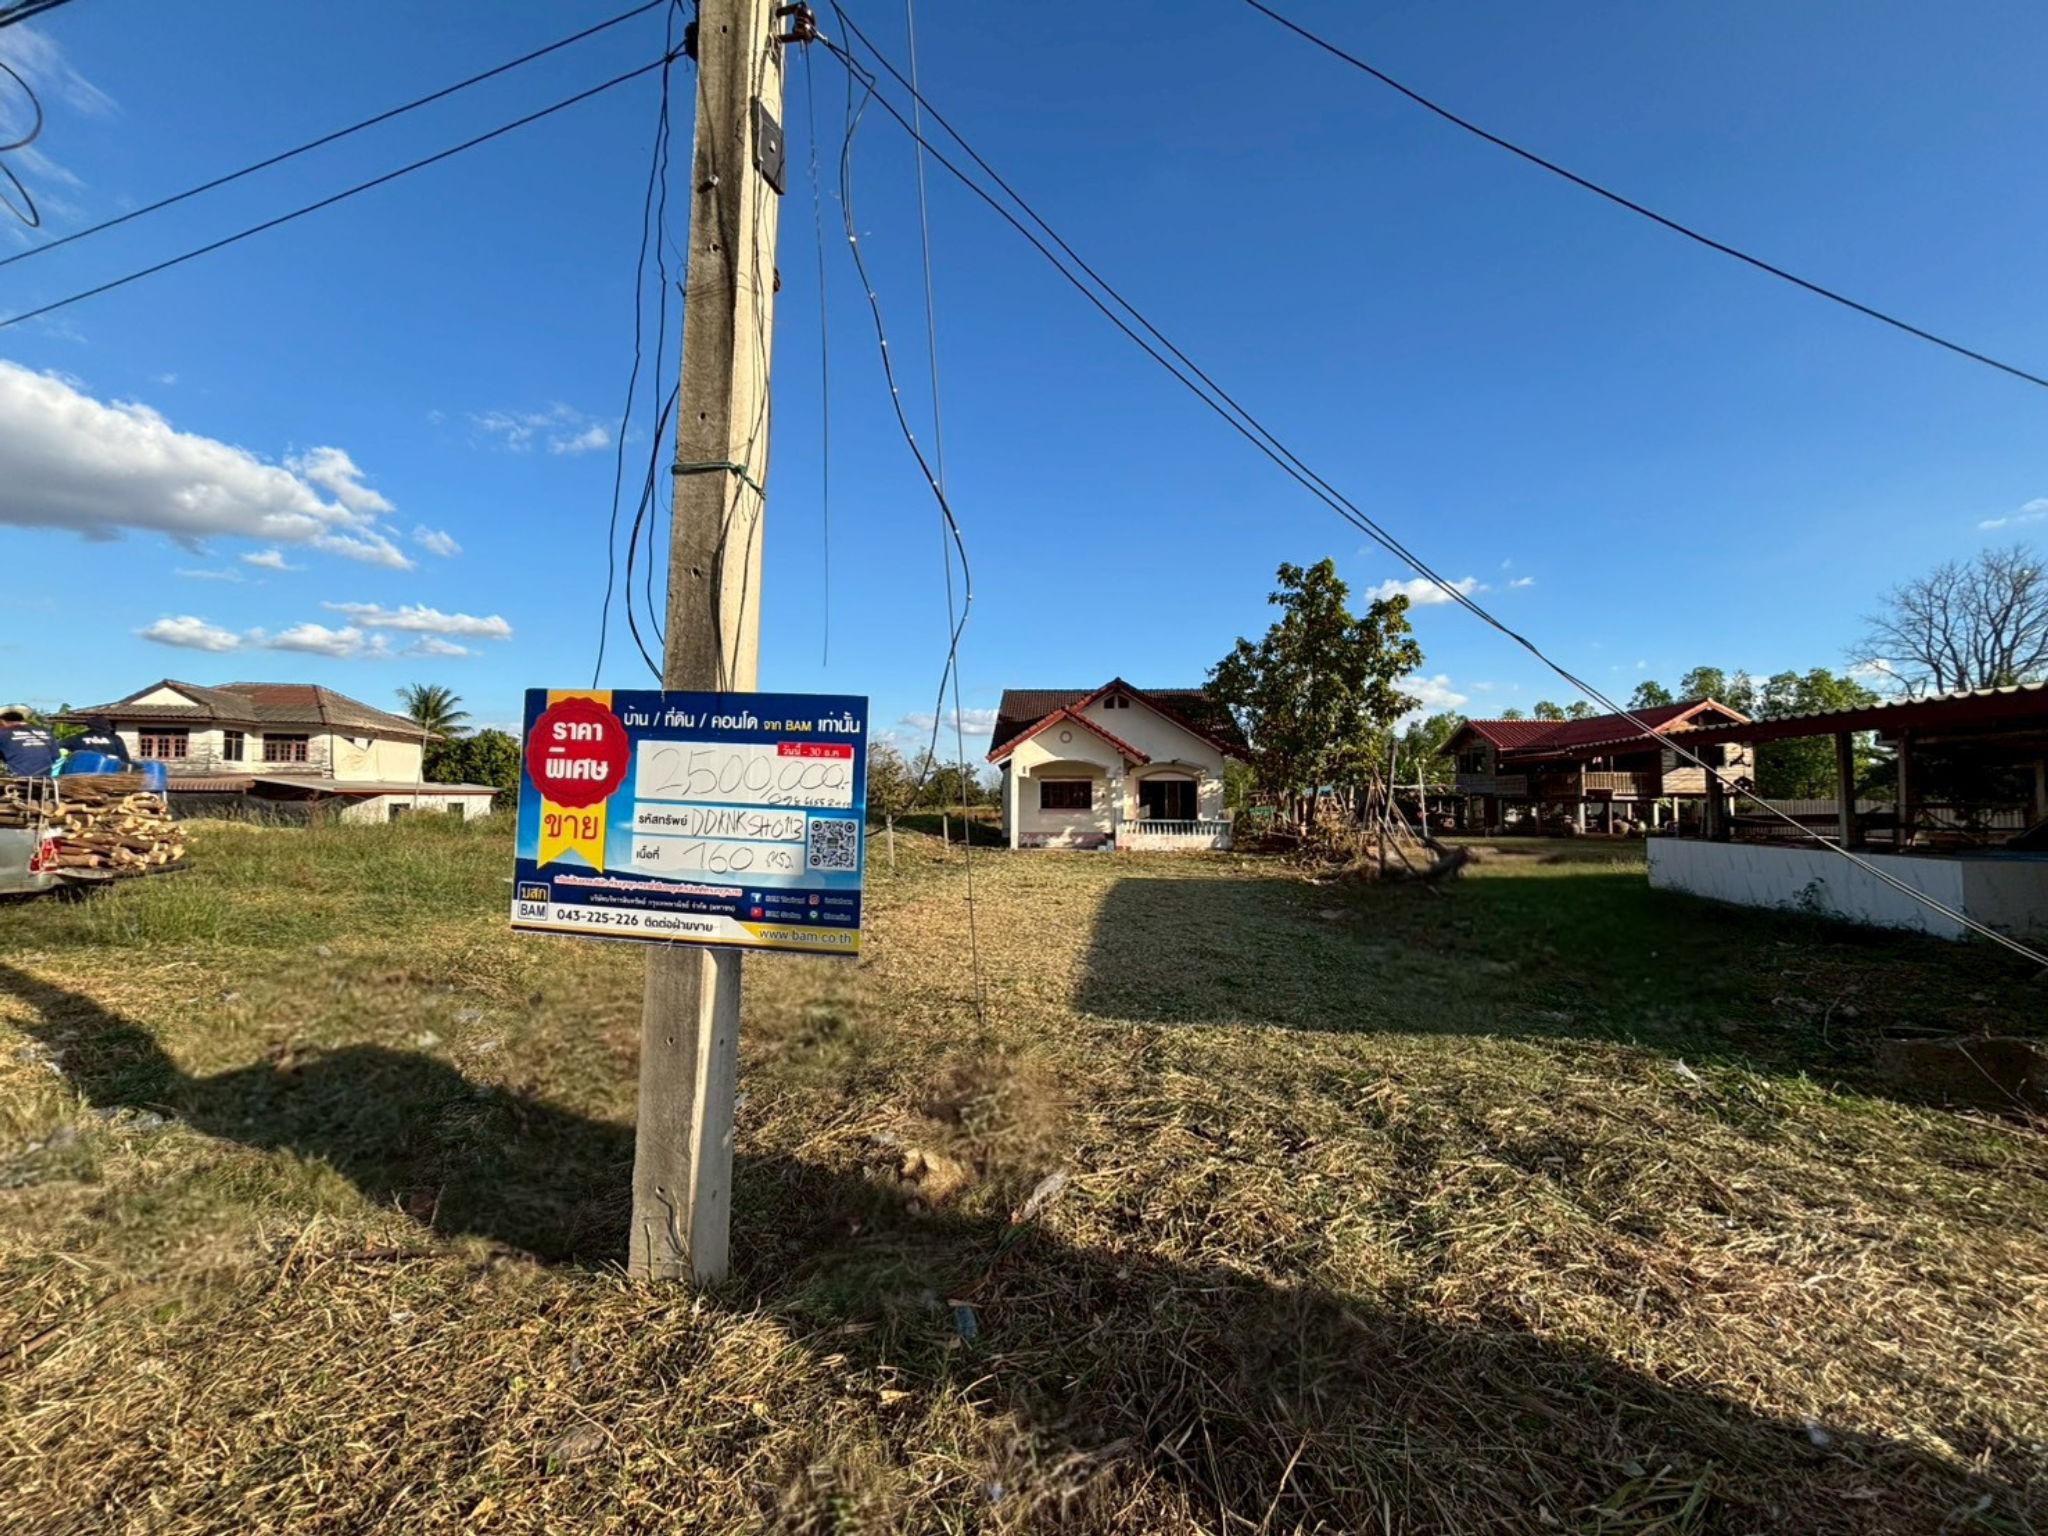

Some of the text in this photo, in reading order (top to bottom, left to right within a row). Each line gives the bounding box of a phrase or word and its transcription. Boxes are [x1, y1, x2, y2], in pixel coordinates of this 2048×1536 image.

[623, 705, 649, 726] บ้าน
[664, 706, 695, 728] ที่ดิน
[711, 710, 759, 730] คอนโด
[763, 720, 782, 731] จาก
[785, 720, 812, 732] BAM
[817, 711, 861, 734] เท่านั้น
[552, 721, 604, 741] ราคา
[545, 746, 609, 781] พิเศษ
[544, 813, 599, 840] ขาย
[638, 813, 688, 826] รหัสทรัพย์
[636, 845, 660, 860] เนื้อที่
[683, 842, 753, 874] 160
[520, 903, 546, 916] BAM
[557, 909, 639, 926] 043-225-226
